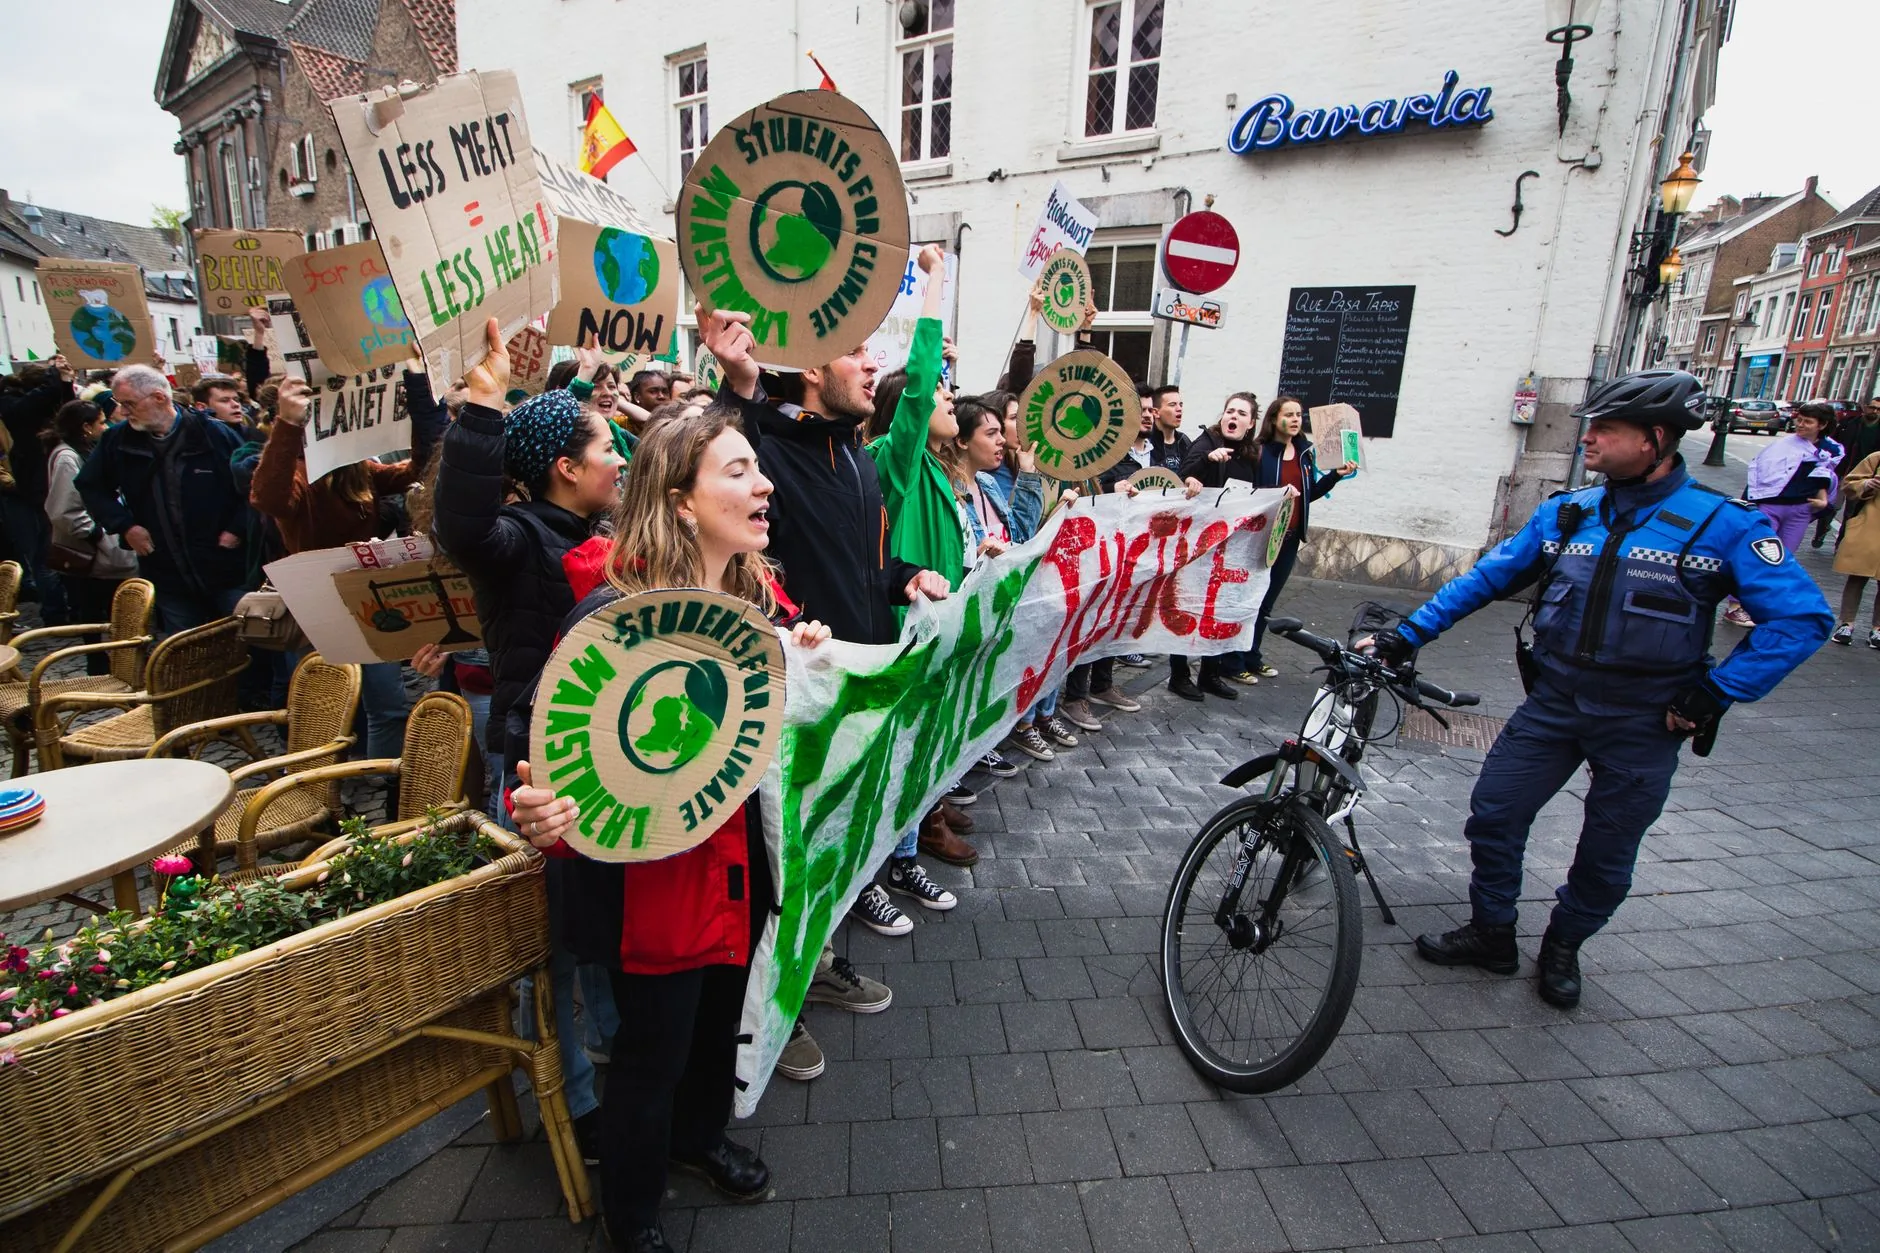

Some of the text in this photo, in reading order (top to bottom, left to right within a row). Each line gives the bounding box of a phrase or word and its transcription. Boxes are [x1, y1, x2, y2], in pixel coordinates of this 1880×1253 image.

[1228, 70, 1493, 153] Bavaria
[379, 112, 517, 209] LESS MEAT
[202, 254, 284, 292] BEELEA
[303, 254, 348, 294] for
[420, 247, 486, 328] LESS
[809, 241, 877, 339] CLIMATE
[1295, 290, 1400, 312] QUE PASA TAPAS
[576, 307, 664, 353] NOW
[299, 383, 388, 442] LANET
[1073, 428, 1120, 470] CLIMATE
[1626, 567, 1677, 584] HANDHAVING
[615, 601, 761, 659] STUDENTS
[545, 644, 650, 849] MAASTRICHT
[679, 719, 765, 832] CLIMATE
